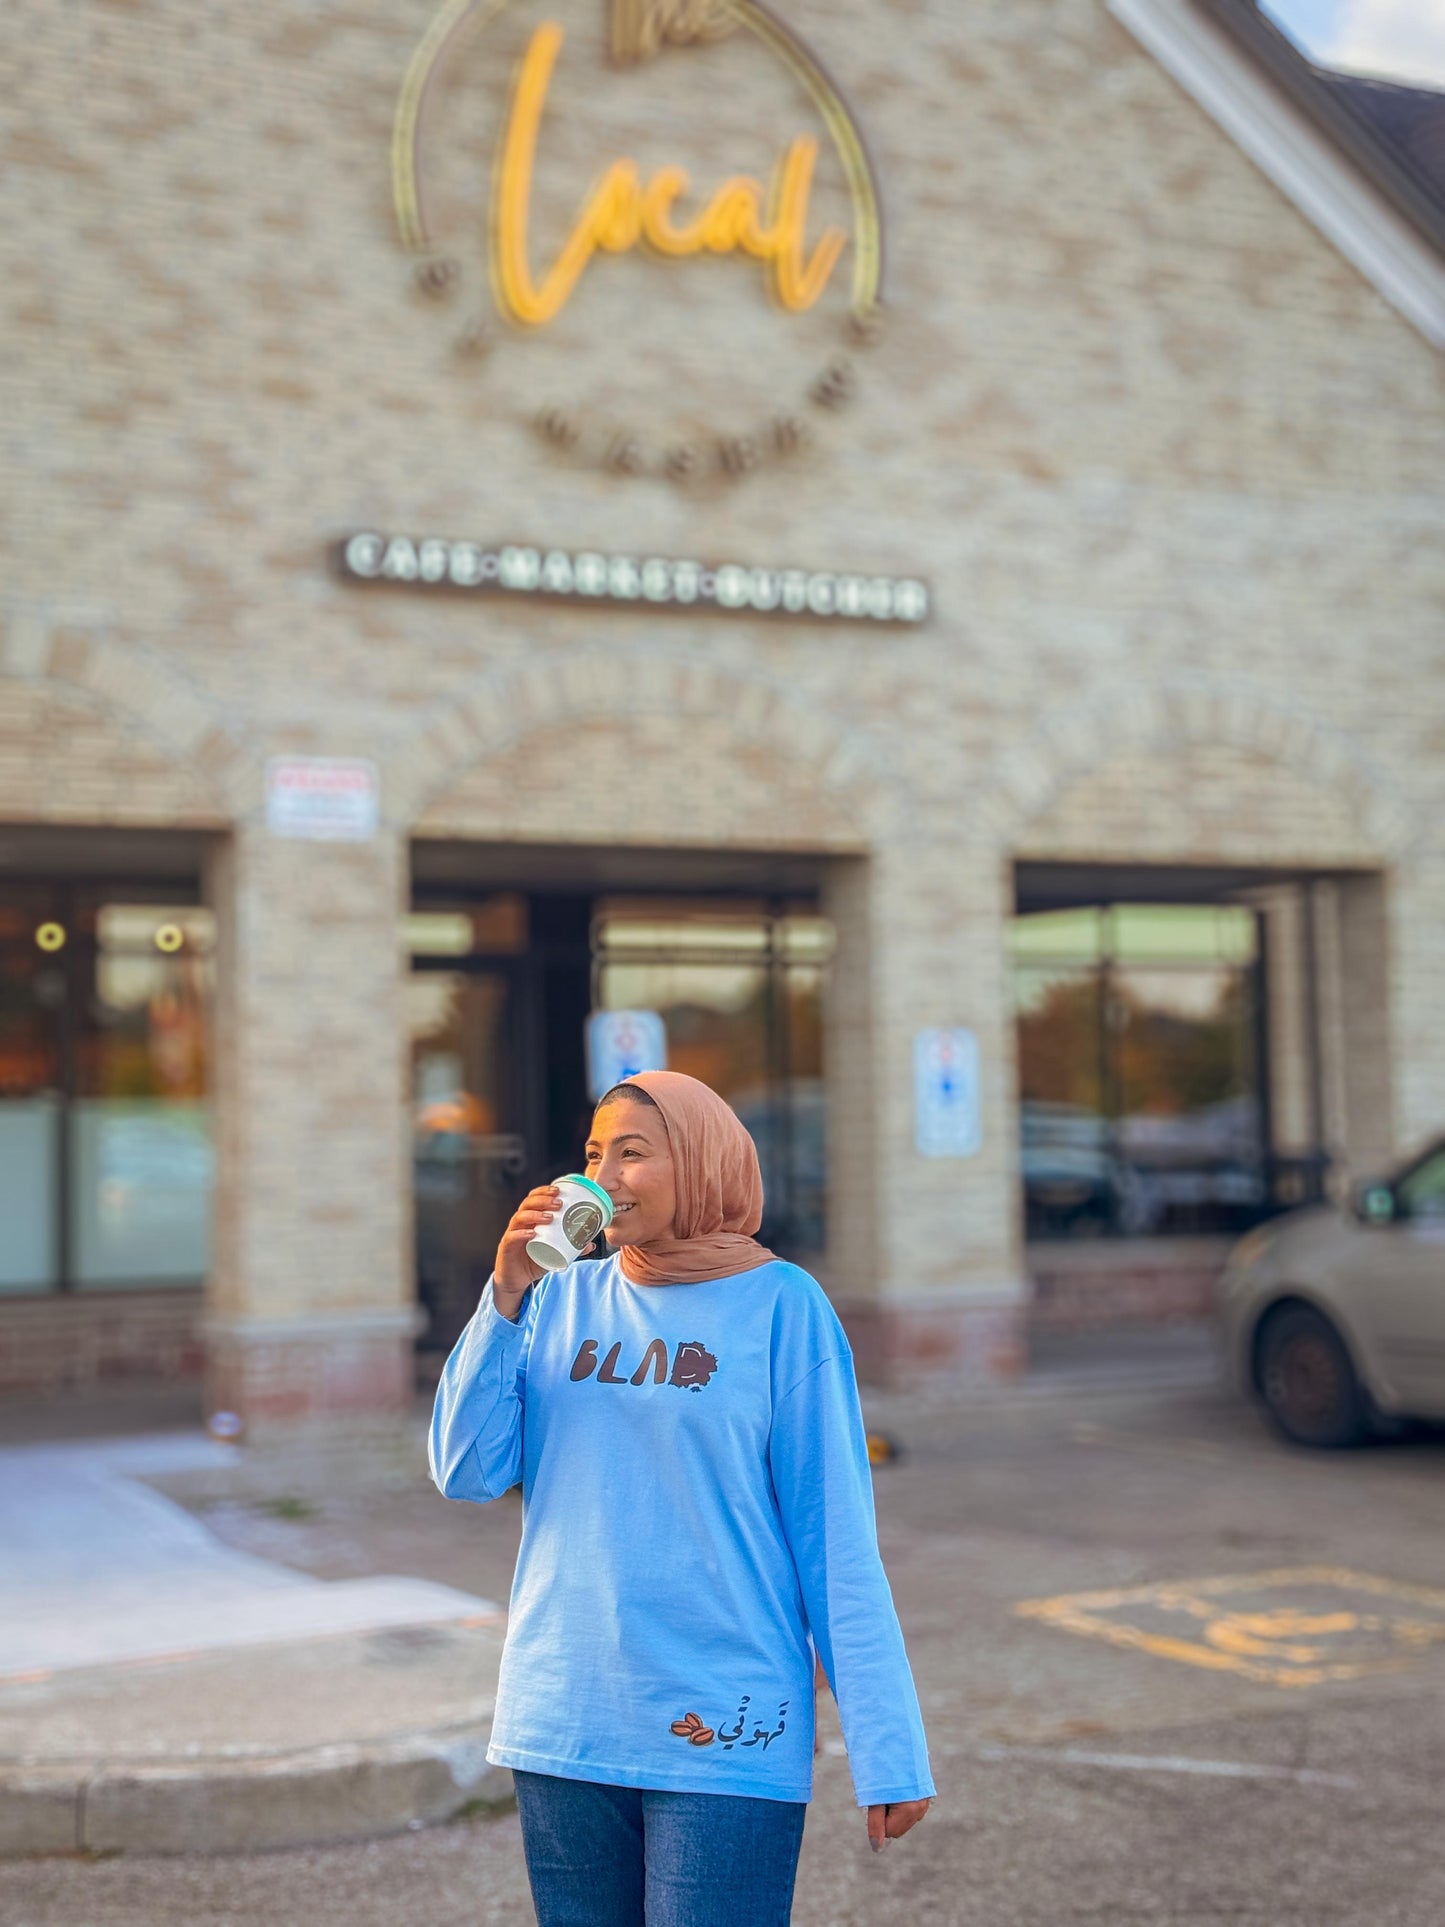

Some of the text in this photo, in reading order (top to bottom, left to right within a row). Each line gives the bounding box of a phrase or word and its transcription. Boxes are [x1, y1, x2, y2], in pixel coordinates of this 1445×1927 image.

[495, 20, 848, 326] Local
[346, 532, 485, 586] CAFE
[499, 545, 703, 604] MARKET
